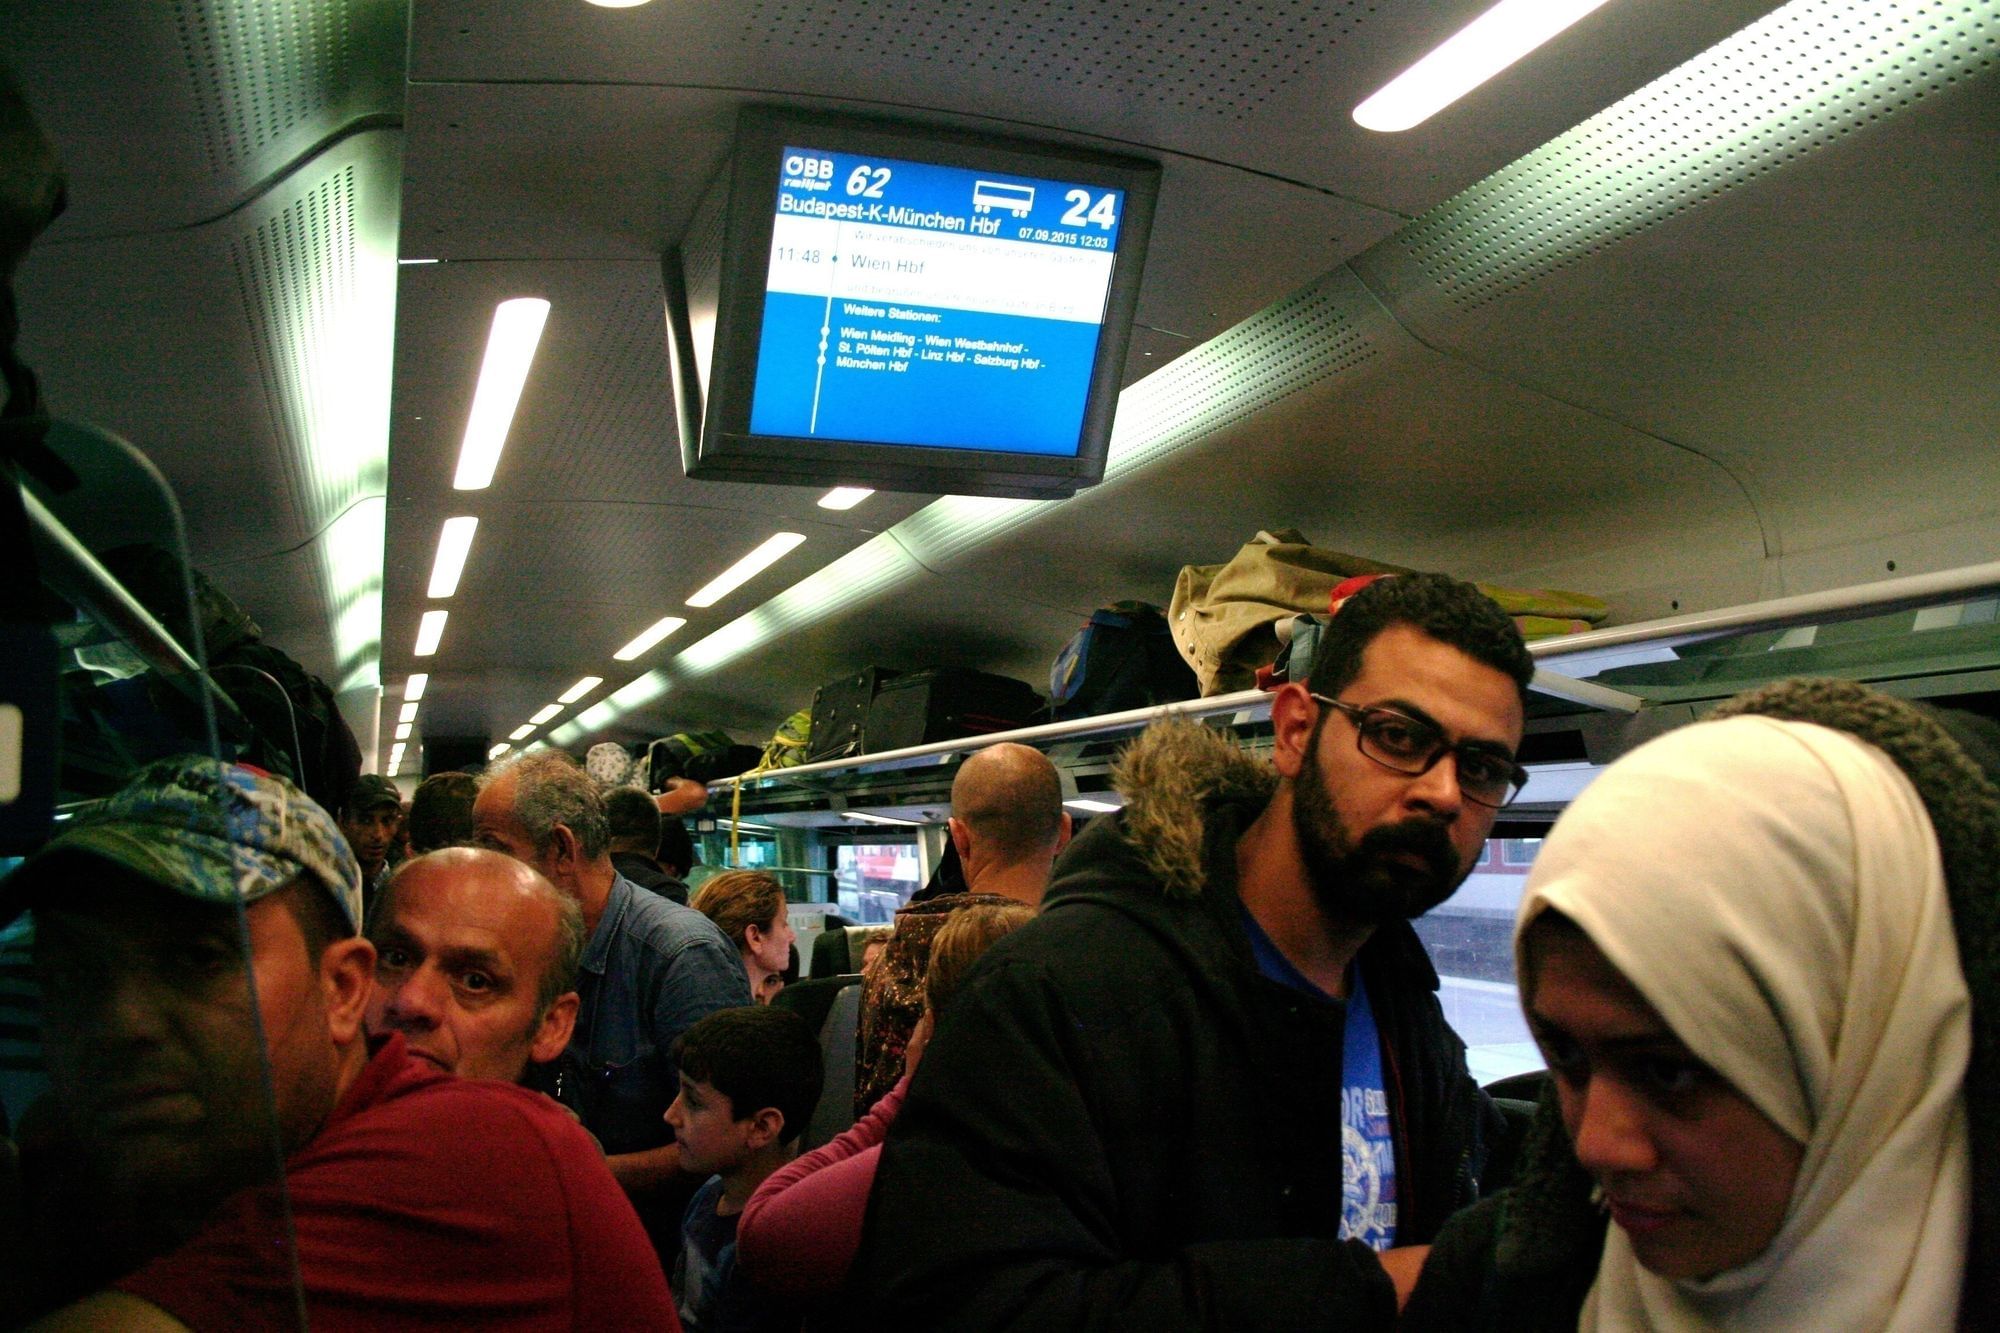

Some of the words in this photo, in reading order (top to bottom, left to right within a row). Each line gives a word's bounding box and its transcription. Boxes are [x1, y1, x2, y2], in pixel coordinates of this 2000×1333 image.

[846, 165, 892, 199] 62
[1061, 189, 1116, 229] 24
[970, 216, 1001, 235] Hbf
[1019, 227, 1077, 245] 07.09.2015
[1080, 233, 1108, 249] 12:03
[778, 247, 821, 264] 11:48
[851, 253, 891, 271] Wien
[897, 259, 925, 274] Hbf
[844, 303, 885, 318] Weitere
[888, 308, 942, 323] Stationen:
[841, 327, 867, 340] Wien
[871, 329, 915, 346] Meidling
[925, 334, 951, 347] Wien
[955, 337, 1023, 354] Westbahnhof
[836, 356, 885, 371] München
[888, 359, 908, 372] Hbf
[838, 342, 852, 354] St.
[856, 342, 890, 356] Pölten
[893, 346, 912, 358] Hbf
[921, 349, 944, 361] Linz
[946, 351, 965, 363] Hbf
[973, 353, 1019, 371] Salzburg
[1021, 357, 1041, 370] Hbf
